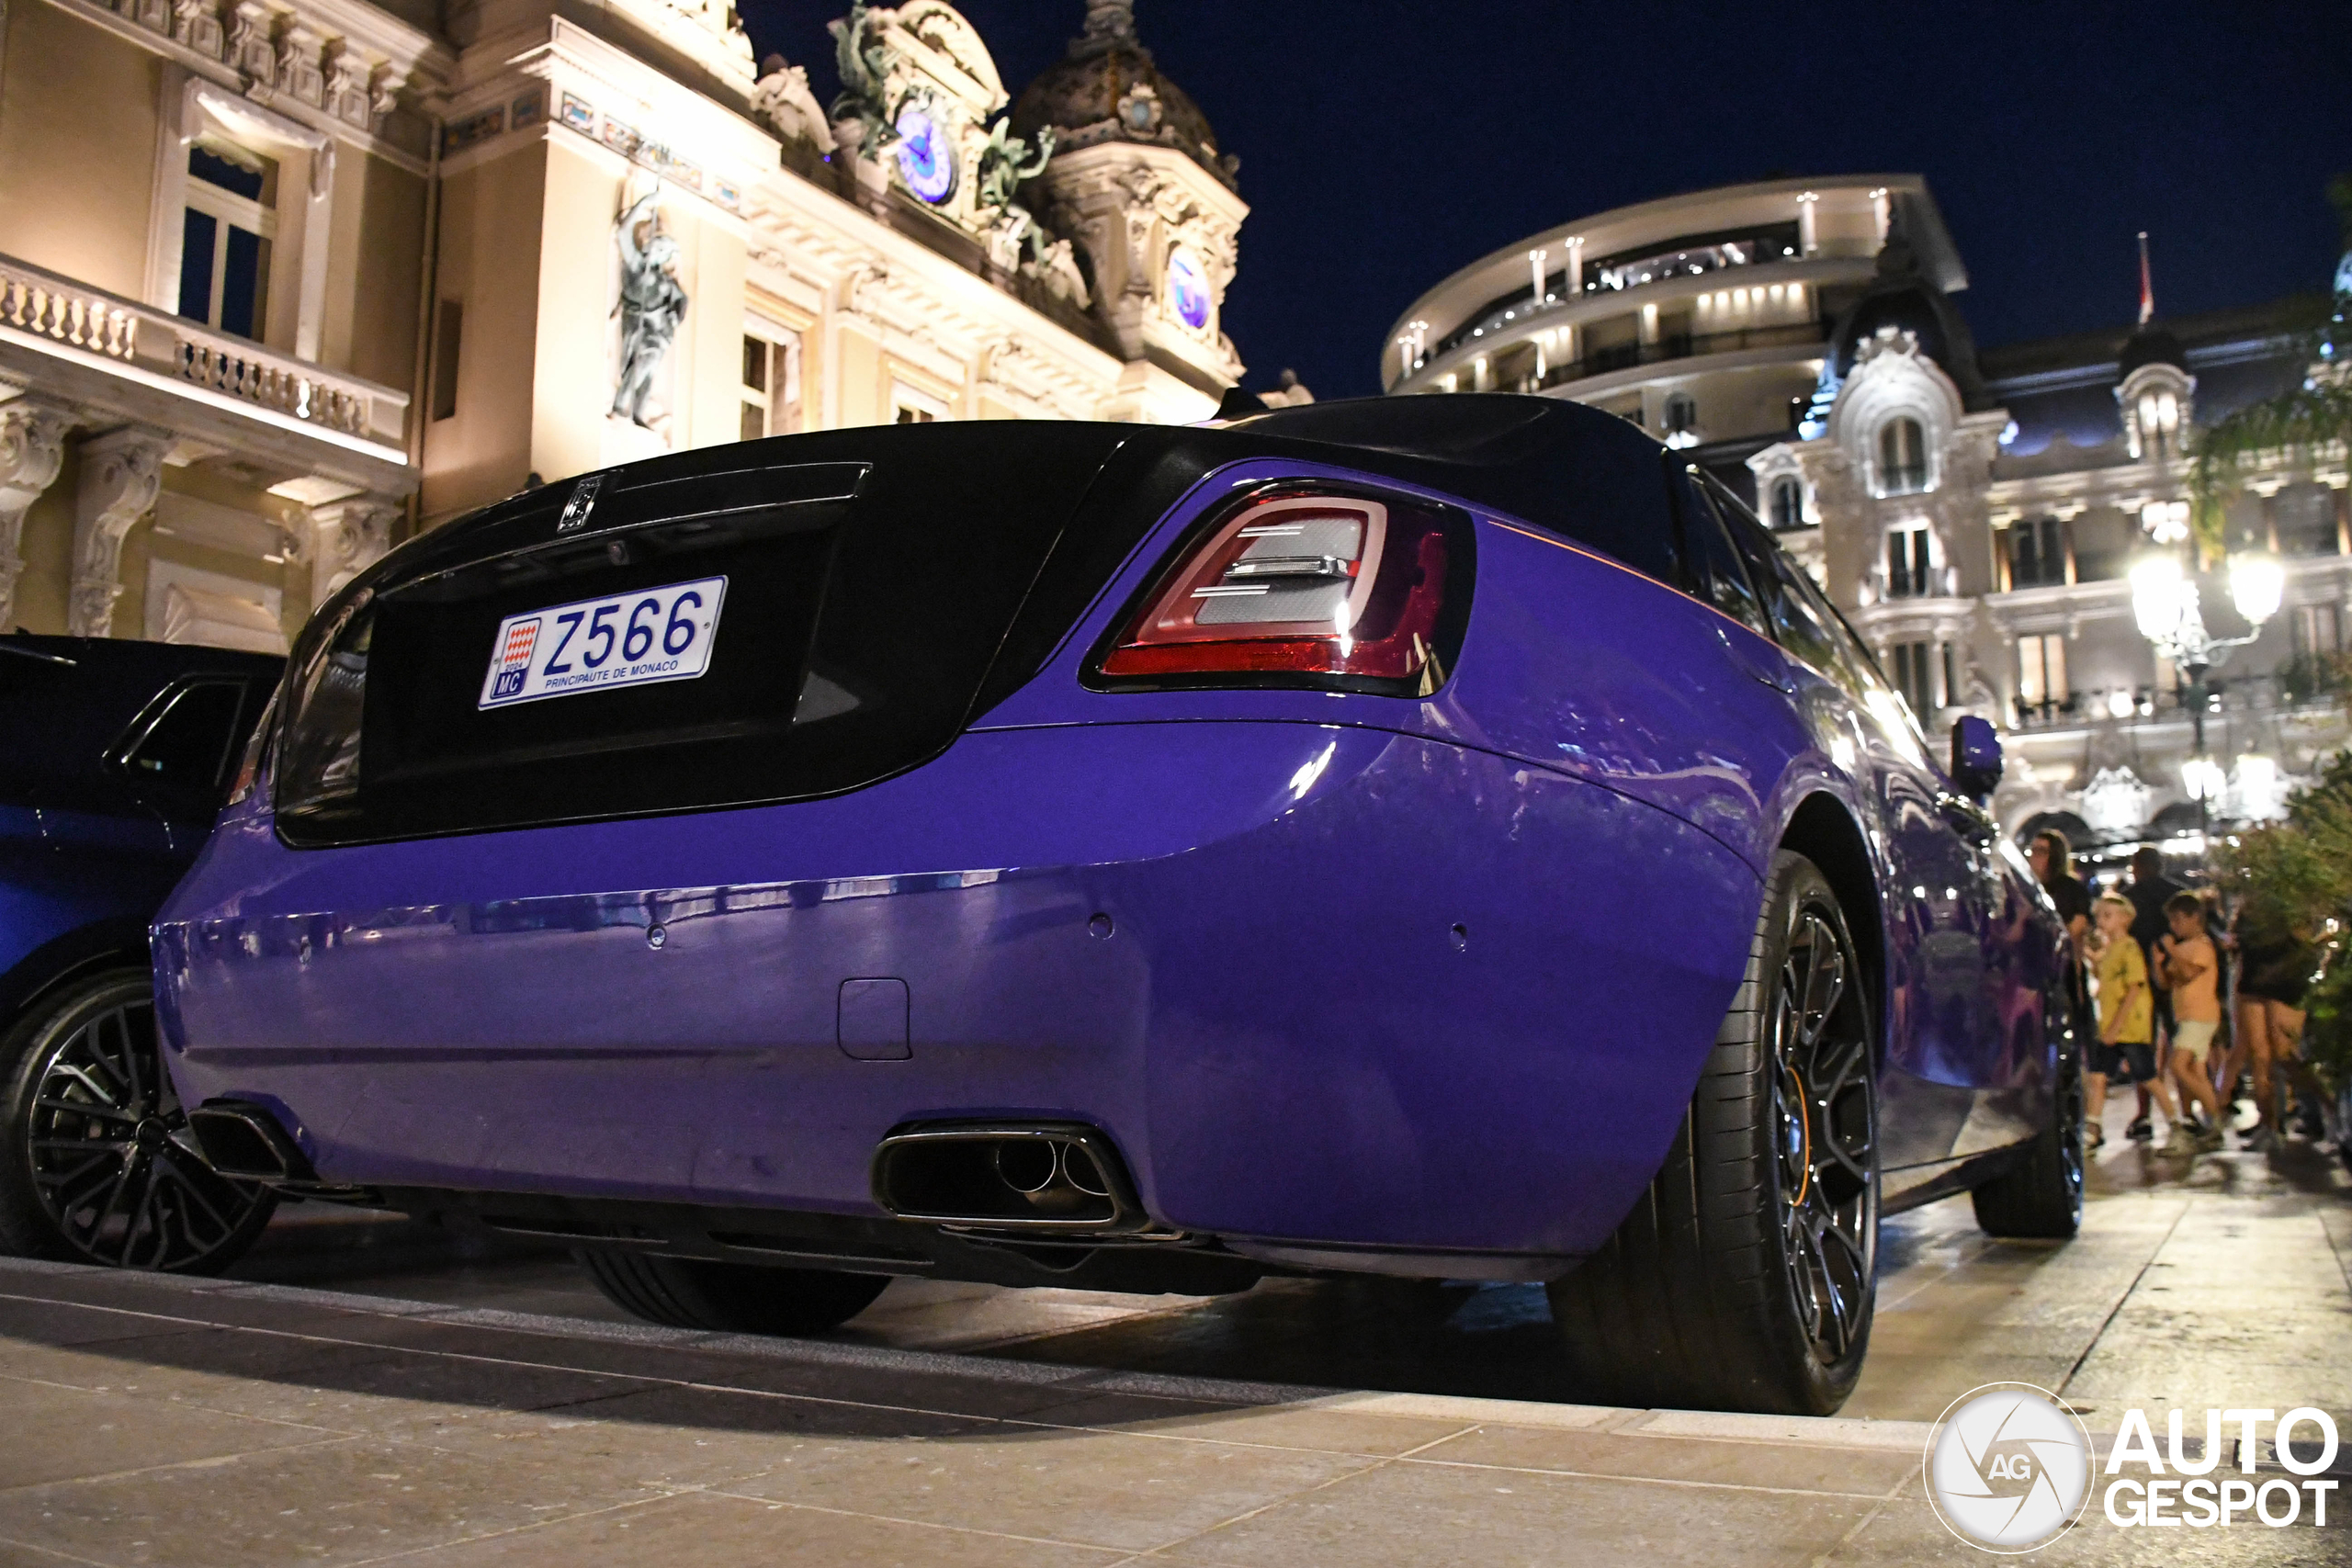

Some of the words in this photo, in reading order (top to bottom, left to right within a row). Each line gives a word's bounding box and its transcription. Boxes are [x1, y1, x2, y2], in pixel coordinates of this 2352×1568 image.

[543, 591, 703, 676] Z566
[504, 661, 524, 672] 2024
[545, 670, 610, 689] PRINCIPAUTE
[613, 667, 628, 679] DE
[630, 660, 679, 676] MONACO
[497, 672, 521, 694] MC
